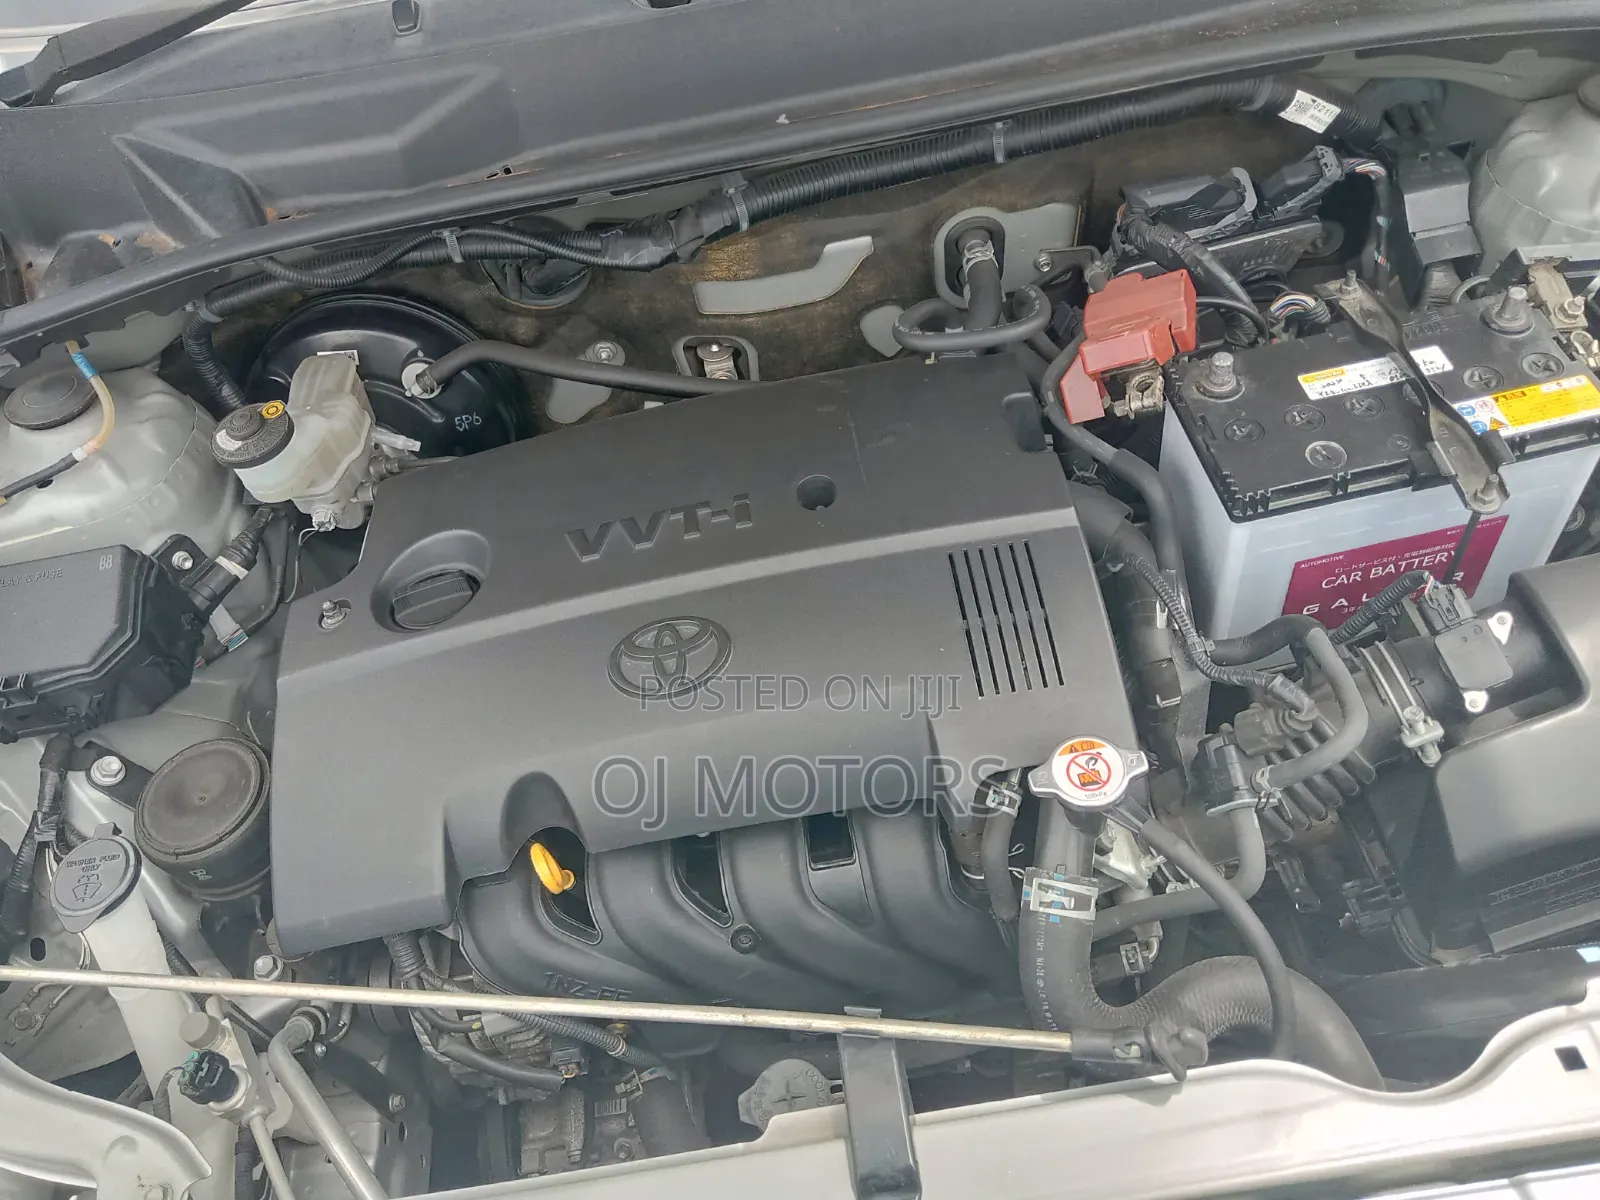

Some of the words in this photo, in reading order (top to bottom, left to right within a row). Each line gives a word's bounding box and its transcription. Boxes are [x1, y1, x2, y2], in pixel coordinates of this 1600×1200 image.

[454, 412, 482, 431] 5P6
[564, 493, 752, 563] VVT-i
[1300, 555, 1344, 569] AUTOMOTIVE
[1321, 571, 1362, 589] CAR
[1370, 551, 1456, 579] BATTER
[36, 568, 63, 581] FUSE
[82, 863, 102, 873] ONLY
